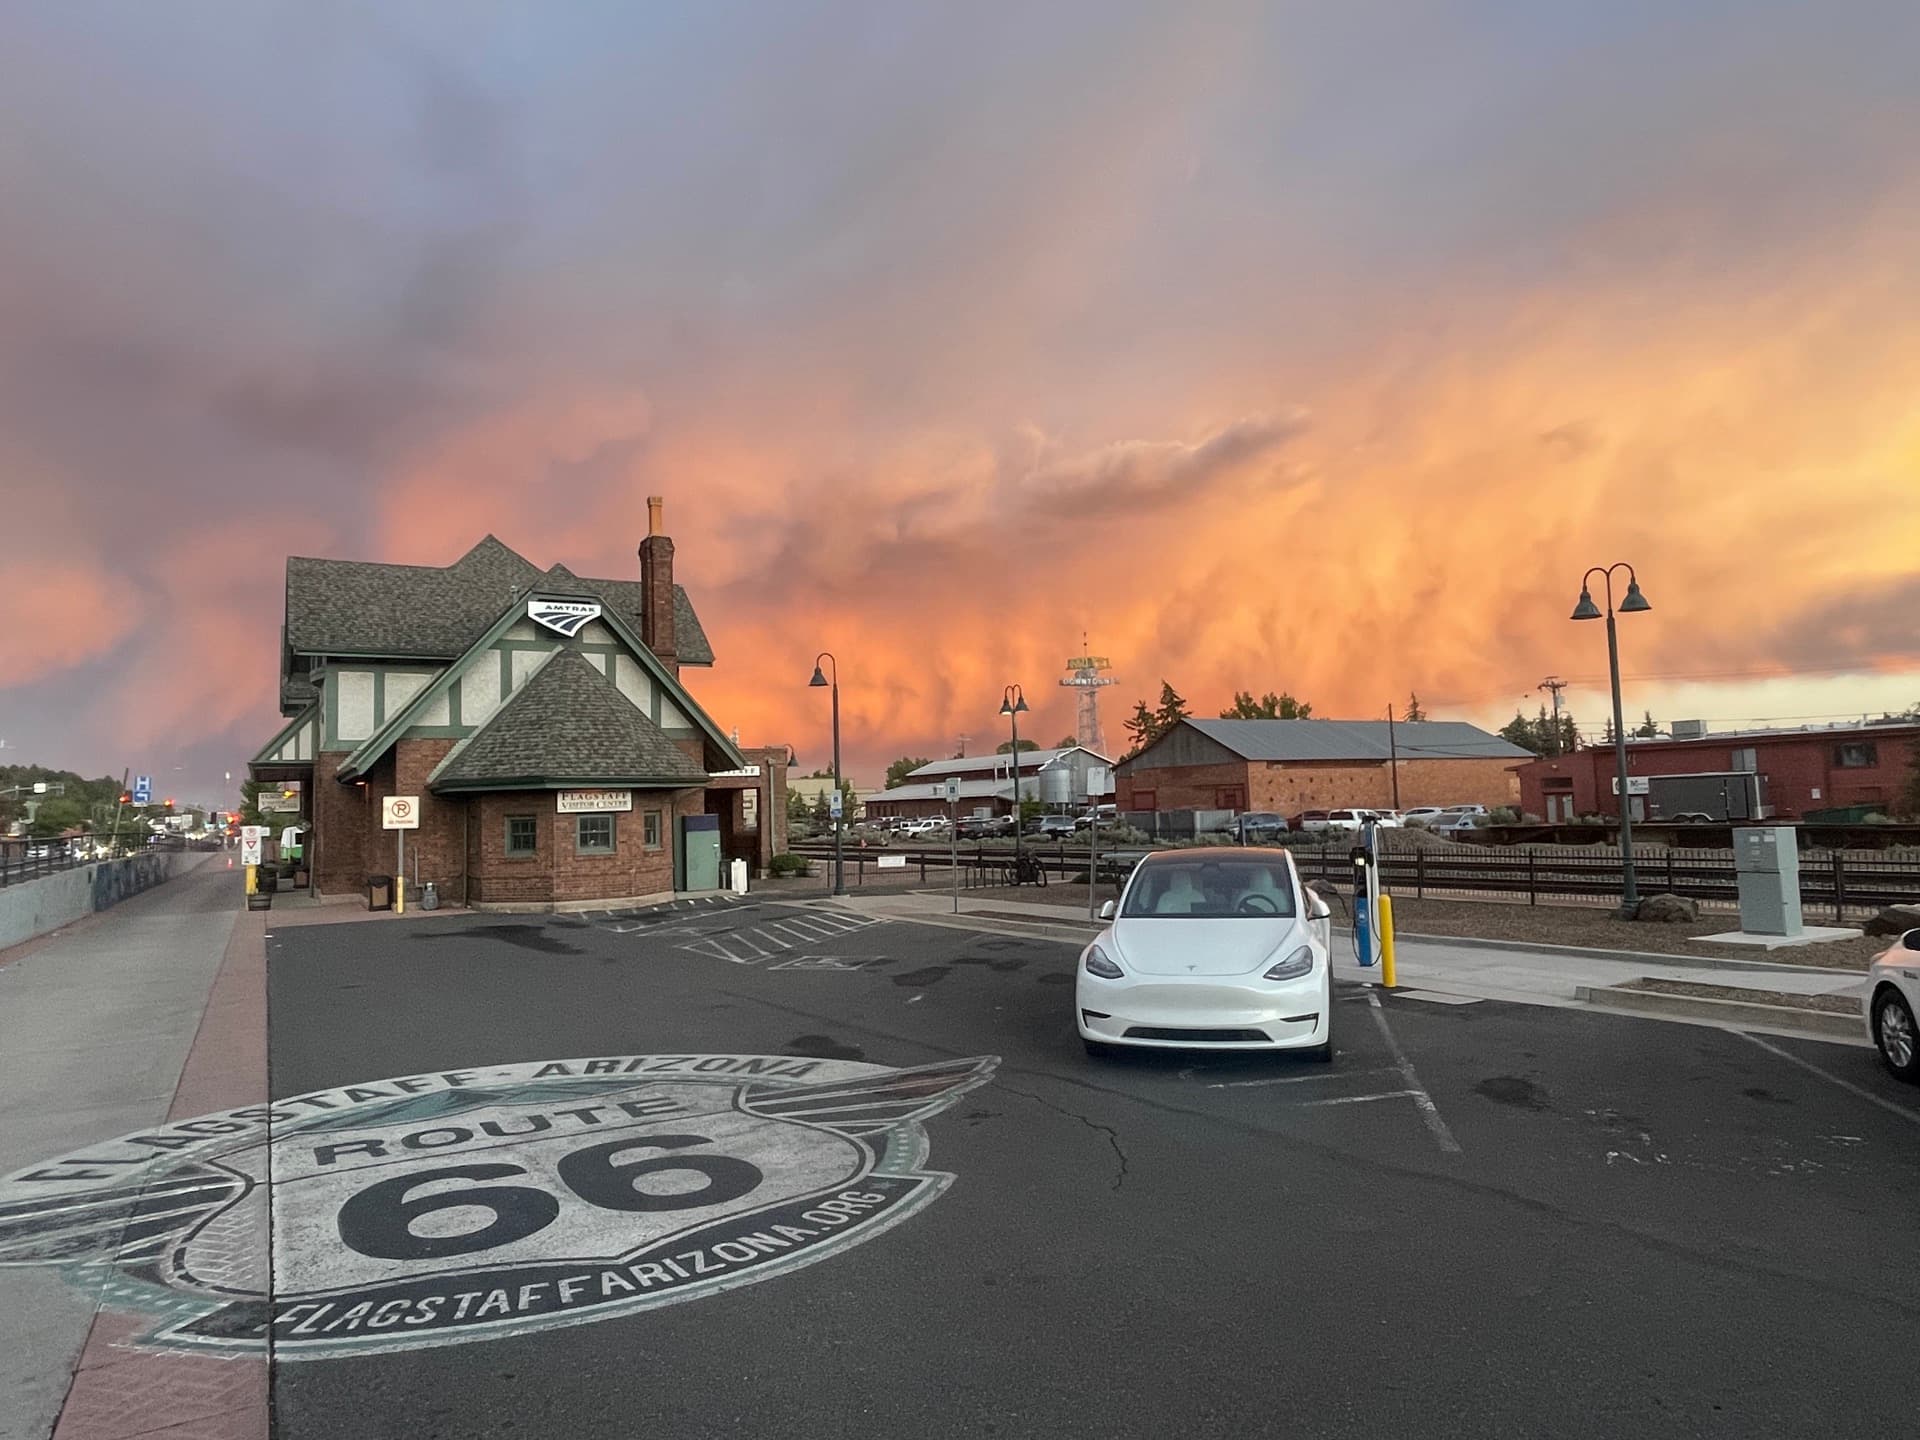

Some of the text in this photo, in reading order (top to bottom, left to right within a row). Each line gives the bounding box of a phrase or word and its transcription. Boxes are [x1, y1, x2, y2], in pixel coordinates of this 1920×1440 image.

[544, 604, 595, 612] AMTRAK
[561, 791, 628, 801] FLAGSTAFF
[12, 1056, 821, 1182] FLAGSTAFF ARIZONA
[312, 1096, 688, 1166] ROUTE
[336, 1133, 764, 1259] 66
[252, 1188, 887, 1335] FLAGSTAFFARIZONA.ORG
